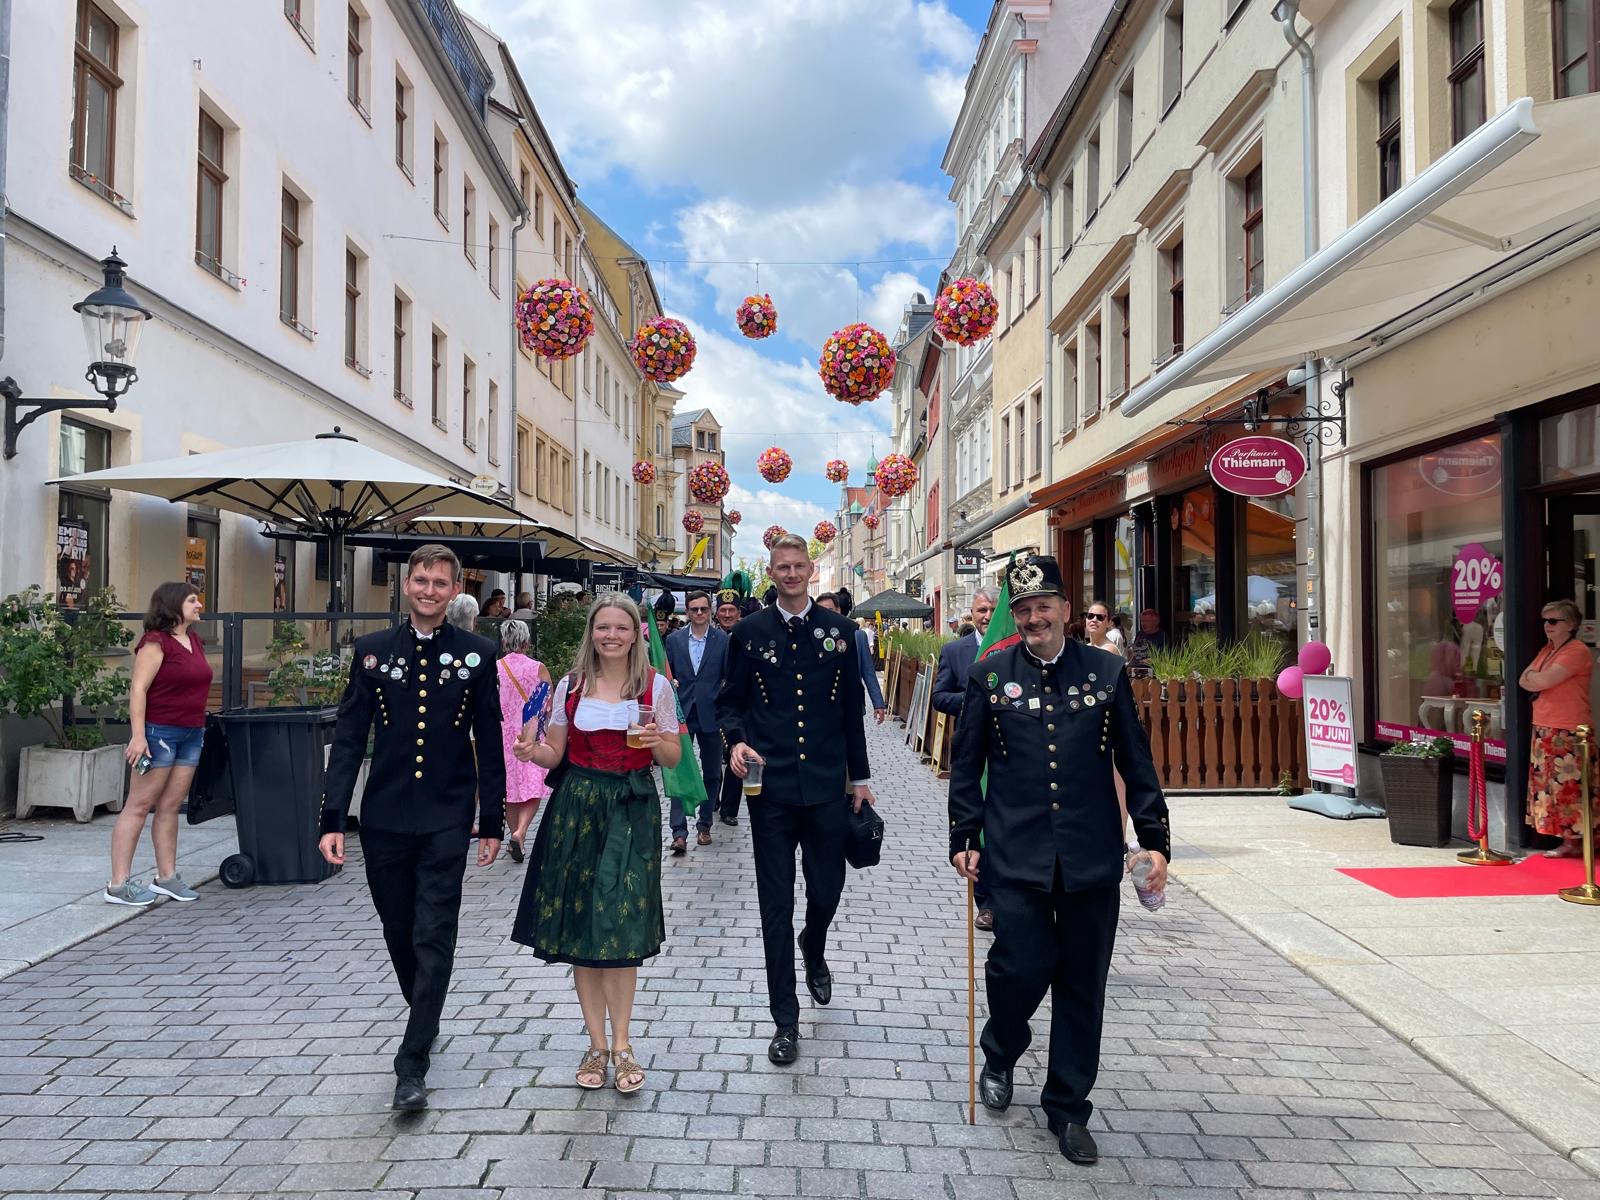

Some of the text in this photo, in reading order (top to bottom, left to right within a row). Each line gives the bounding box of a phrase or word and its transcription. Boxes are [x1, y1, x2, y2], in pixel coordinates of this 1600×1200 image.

[1230, 448, 1280, 459] Parfümerie
[1222, 457, 1286, 468] Thiemann
[1312, 724, 1350, 742] IM JUNI
[1378, 725, 1403, 738] Thiemann
